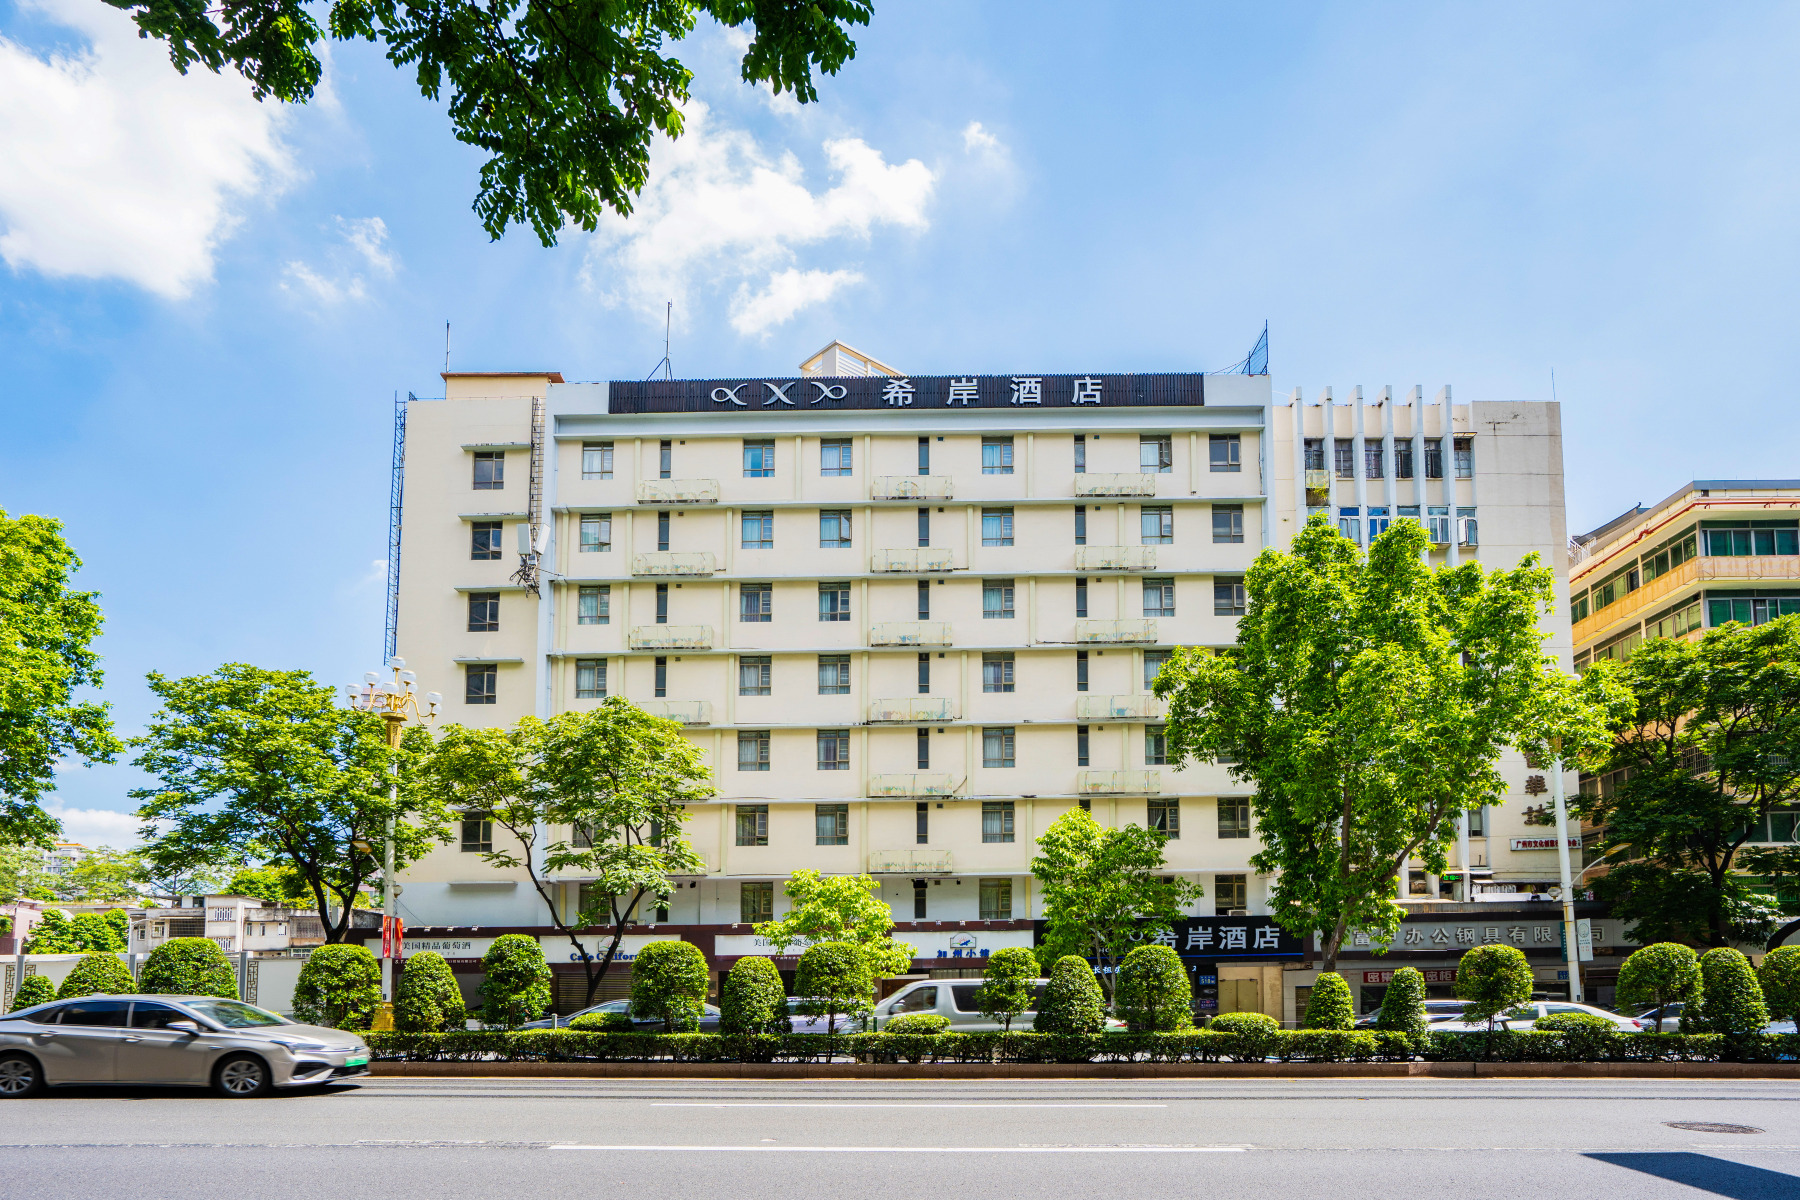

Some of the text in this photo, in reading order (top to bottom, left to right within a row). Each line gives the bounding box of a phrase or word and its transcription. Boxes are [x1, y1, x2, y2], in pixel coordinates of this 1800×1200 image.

[882, 376, 1102, 406] 希岸酒店
[1151, 925, 1280, 950] 希岸酒店
[1353, 925, 1606, 946] 富办公钢具有限司
